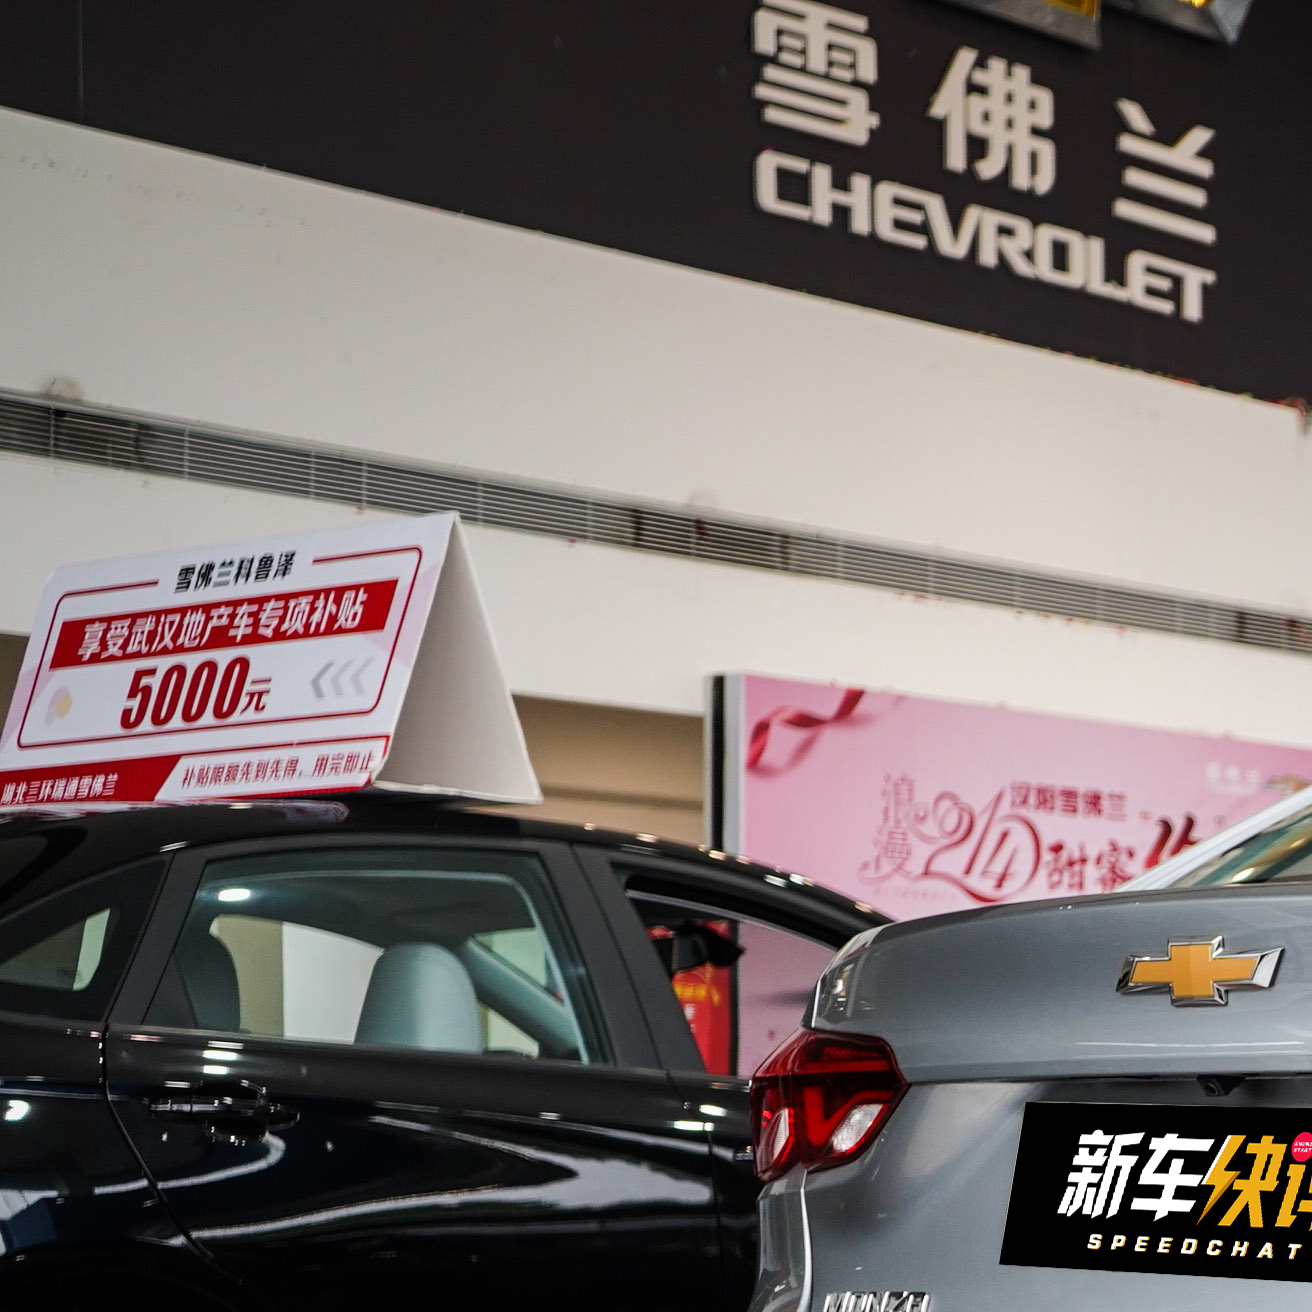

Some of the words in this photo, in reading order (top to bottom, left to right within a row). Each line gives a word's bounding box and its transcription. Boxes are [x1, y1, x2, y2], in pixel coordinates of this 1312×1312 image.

[752, 0, 1217, 247] 雪佛兰
[754, 149, 1217, 324] CHEVROLET
[174, 549, 298, 595] 雪佛兰科鲁泽
[77, 587, 367, 662] 享受武汉地产车专项补贴
[120, 656, 272, 731] 5000元
[1009, 780, 1128, 823] 汉阳雪佛兰
